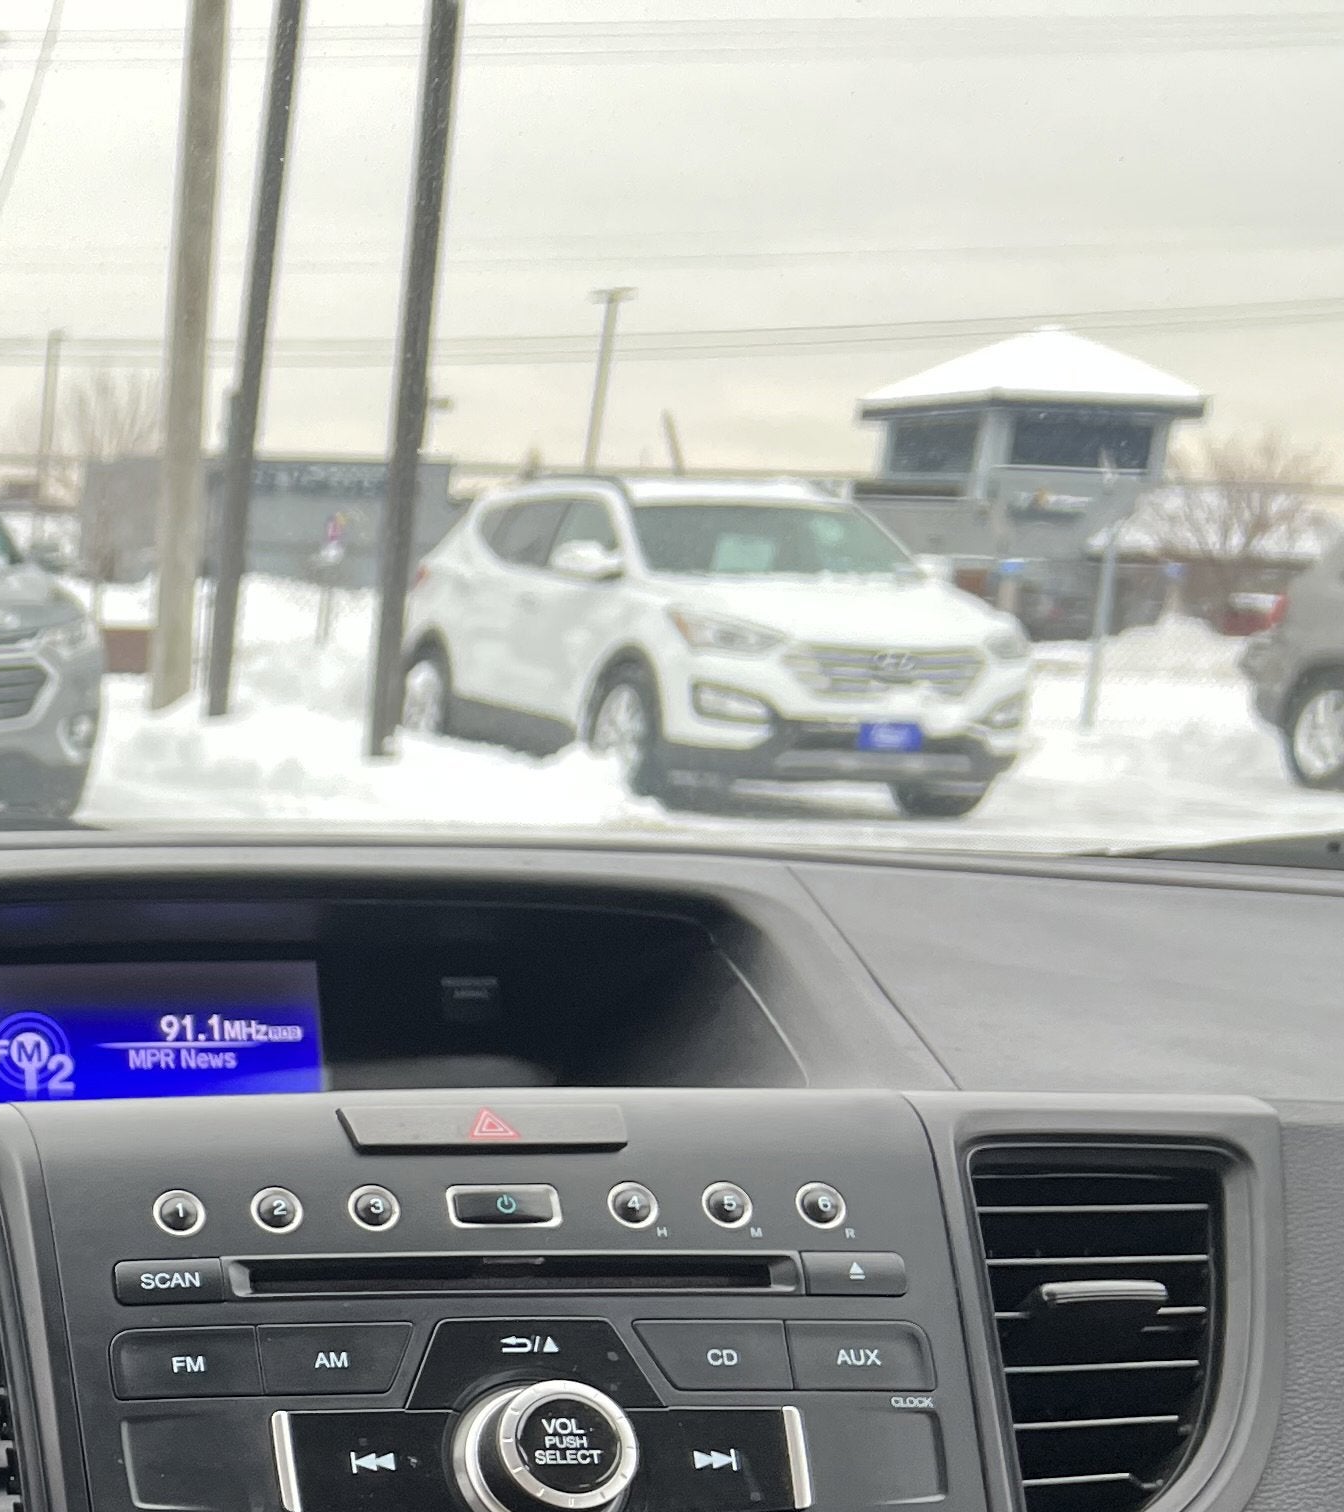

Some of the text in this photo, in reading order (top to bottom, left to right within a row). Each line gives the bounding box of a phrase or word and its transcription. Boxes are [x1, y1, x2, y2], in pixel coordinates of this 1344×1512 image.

[129, 1049, 237, 1070] MPR News
[174, 1203, 186, 1218] 1
[272, 1200, 287, 1216] 2
[369, 1198, 384, 1215] 3
[627, 1195, 641, 1211] 4
[724, 1195, 737, 1211] 5
[818, 1196, 831, 1212] 6
[657, 1227, 668, 1237] H
[751, 1227, 762, 1238] M
[845, 1228, 856, 1238] R
[140, 1271, 201, 1290] SCAN
[171, 1356, 206, 1374] FM
[314, 1351, 349, 1369] AM
[706, 1348, 738, 1367] CD
[837, 1348, 882, 1366] AUX
[891, 1396, 934, 1408] CLOCK
[541, 1417, 585, 1434] VOL
[544, 1435, 588, 1449] PUSH
[534, 1449, 602, 1465] SELECT
